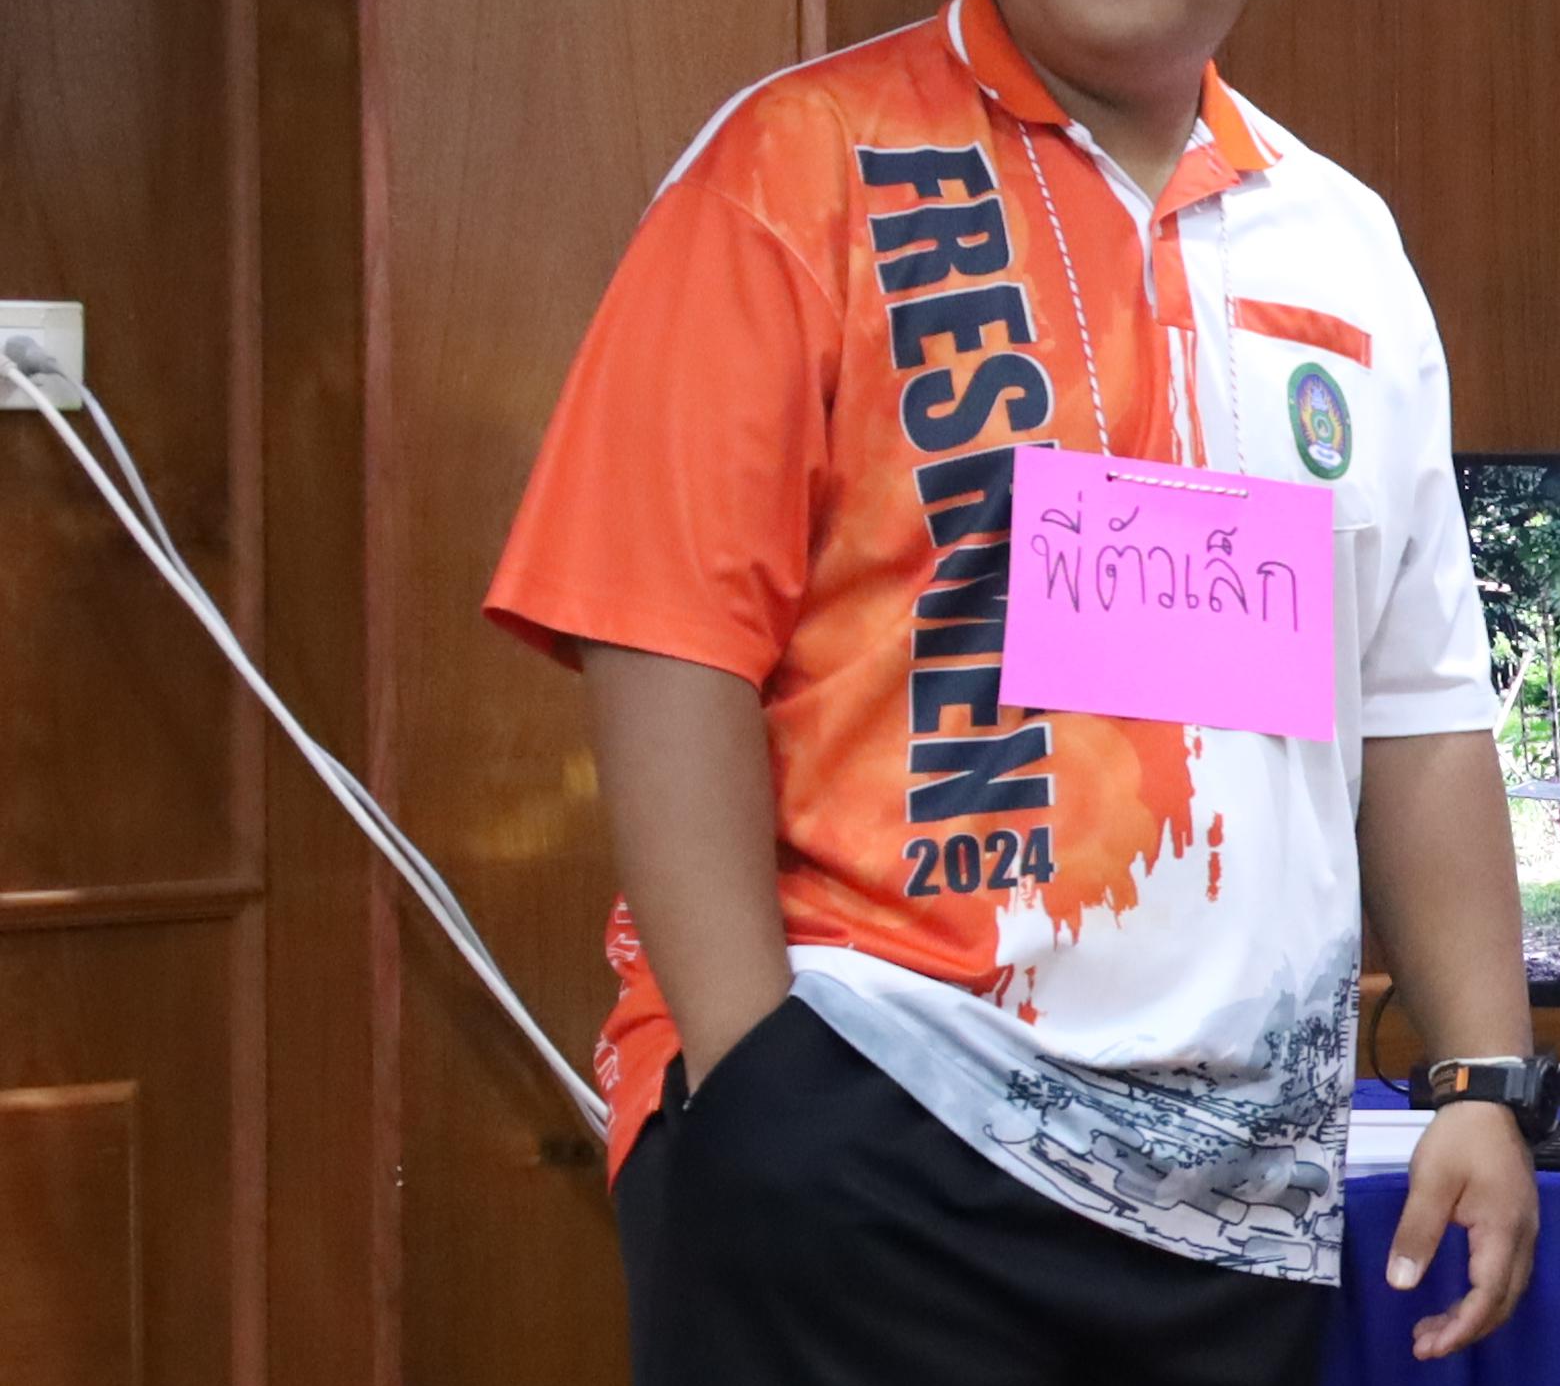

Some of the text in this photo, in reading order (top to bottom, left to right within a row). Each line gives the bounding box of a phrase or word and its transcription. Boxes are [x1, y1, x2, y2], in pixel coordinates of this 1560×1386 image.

[854, 143, 1058, 824] FRESHMEN
[1030, 490, 1298, 632] พี่ตัวเล็ก
[902, 824, 1055, 898] 2024
